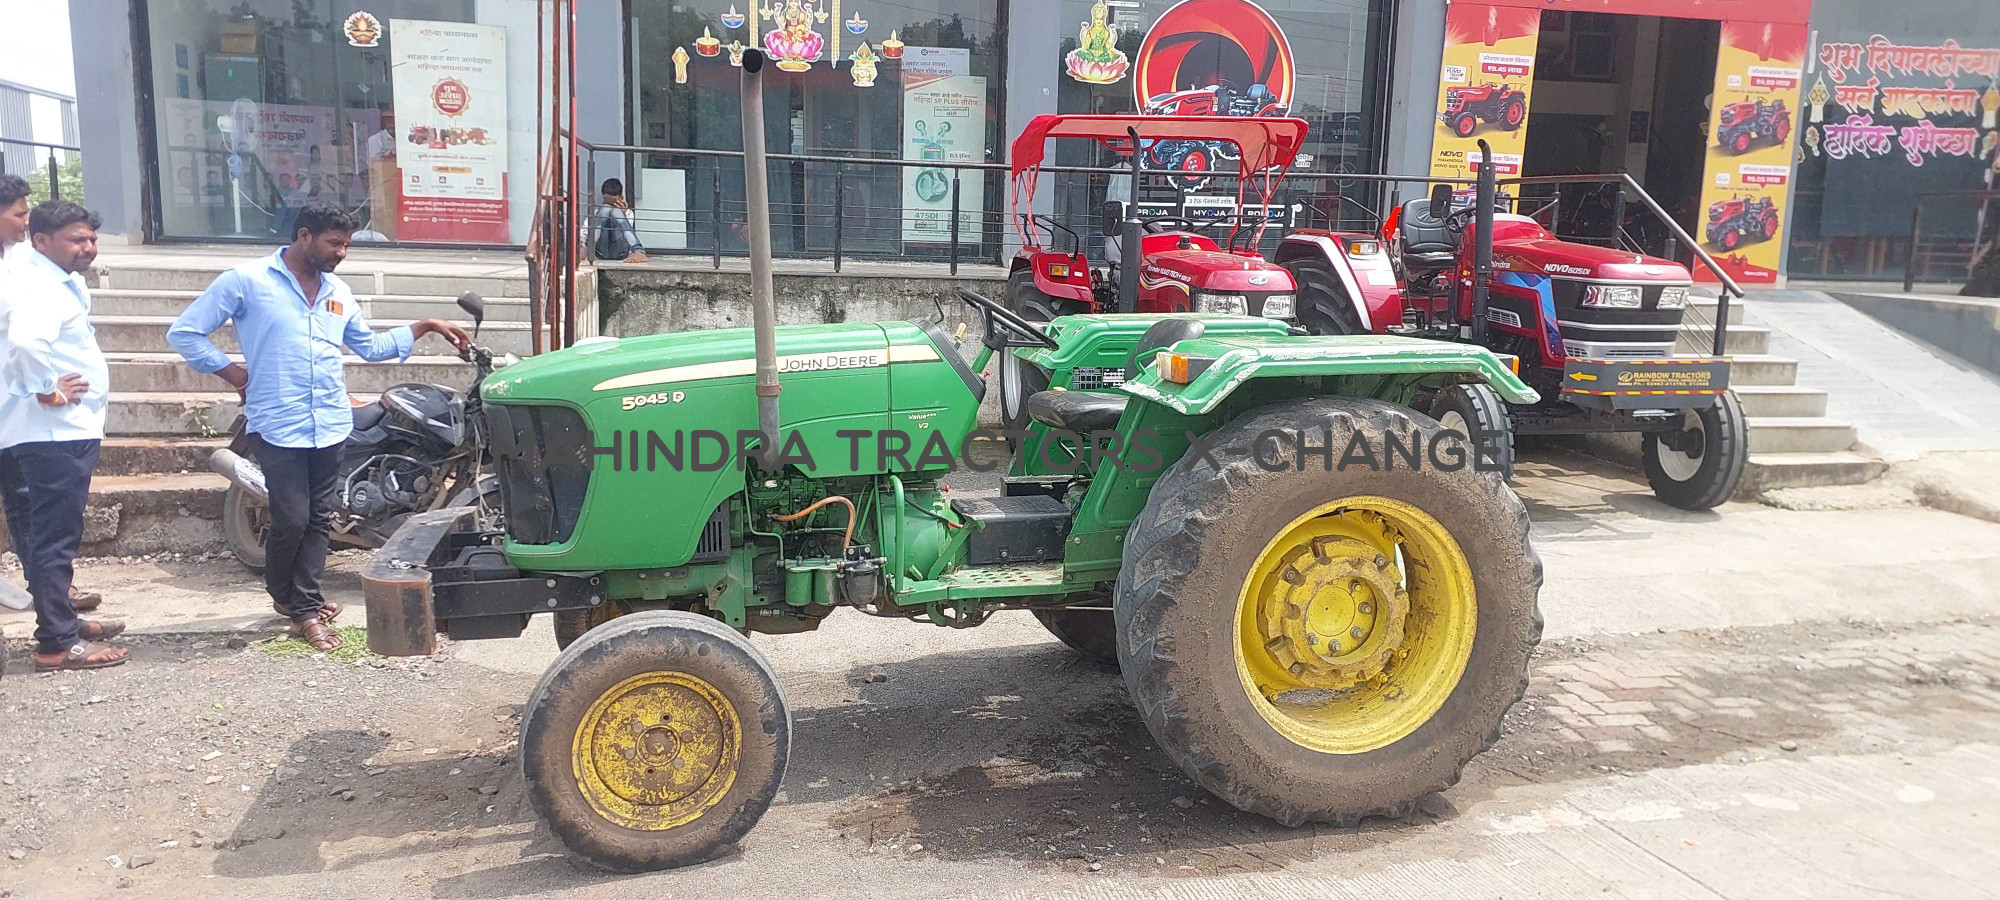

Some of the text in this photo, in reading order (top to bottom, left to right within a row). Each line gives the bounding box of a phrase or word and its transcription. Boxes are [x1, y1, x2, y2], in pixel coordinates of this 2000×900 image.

[1819, 43, 1865, 83] शुभ
[1834, 76, 1880, 115] सर्व
[1823, 114, 1897, 159] हार्दिक
[914, 212, 938, 220] 475DI
[947, 213, 971, 221] 55DI
[1544, 258, 1570, 273] NOVO
[780, 355, 878, 372] JOHN DEERE
[1633, 371, 1712, 380] RAINBOW TRACTORS
[622, 391, 686, 411] 5045 D
